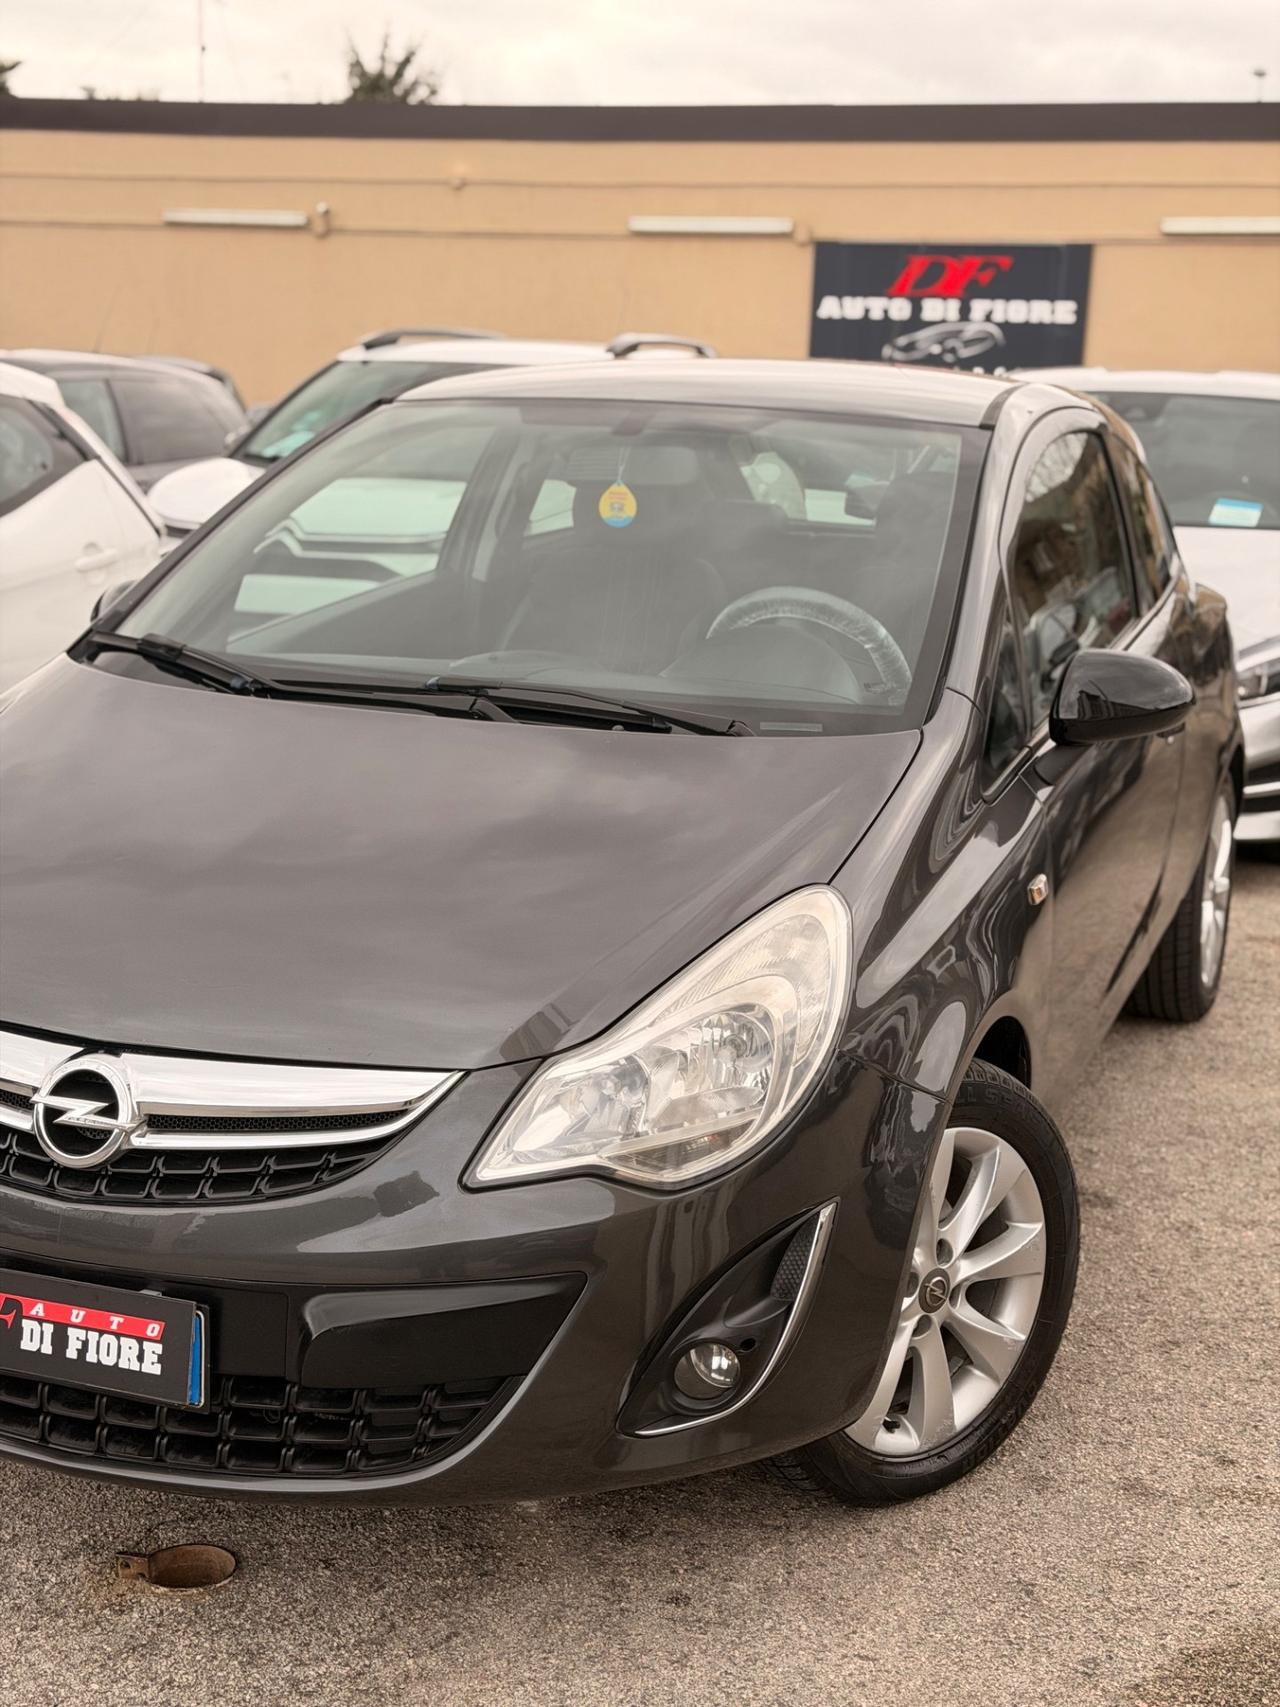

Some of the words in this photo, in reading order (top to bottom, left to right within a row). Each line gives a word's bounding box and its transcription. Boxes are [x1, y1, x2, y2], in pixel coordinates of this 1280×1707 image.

[888, 255, 1014, 298] DF
[816, 295, 913, 321] AUTO
[920, 297, 962, 322] DI
[969, 298, 1079, 325] FIORE
[29, 1302, 162, 1338] AUTO
[20, 1318, 54, 1355] DI
[65, 1326, 163, 1376] FIORE
